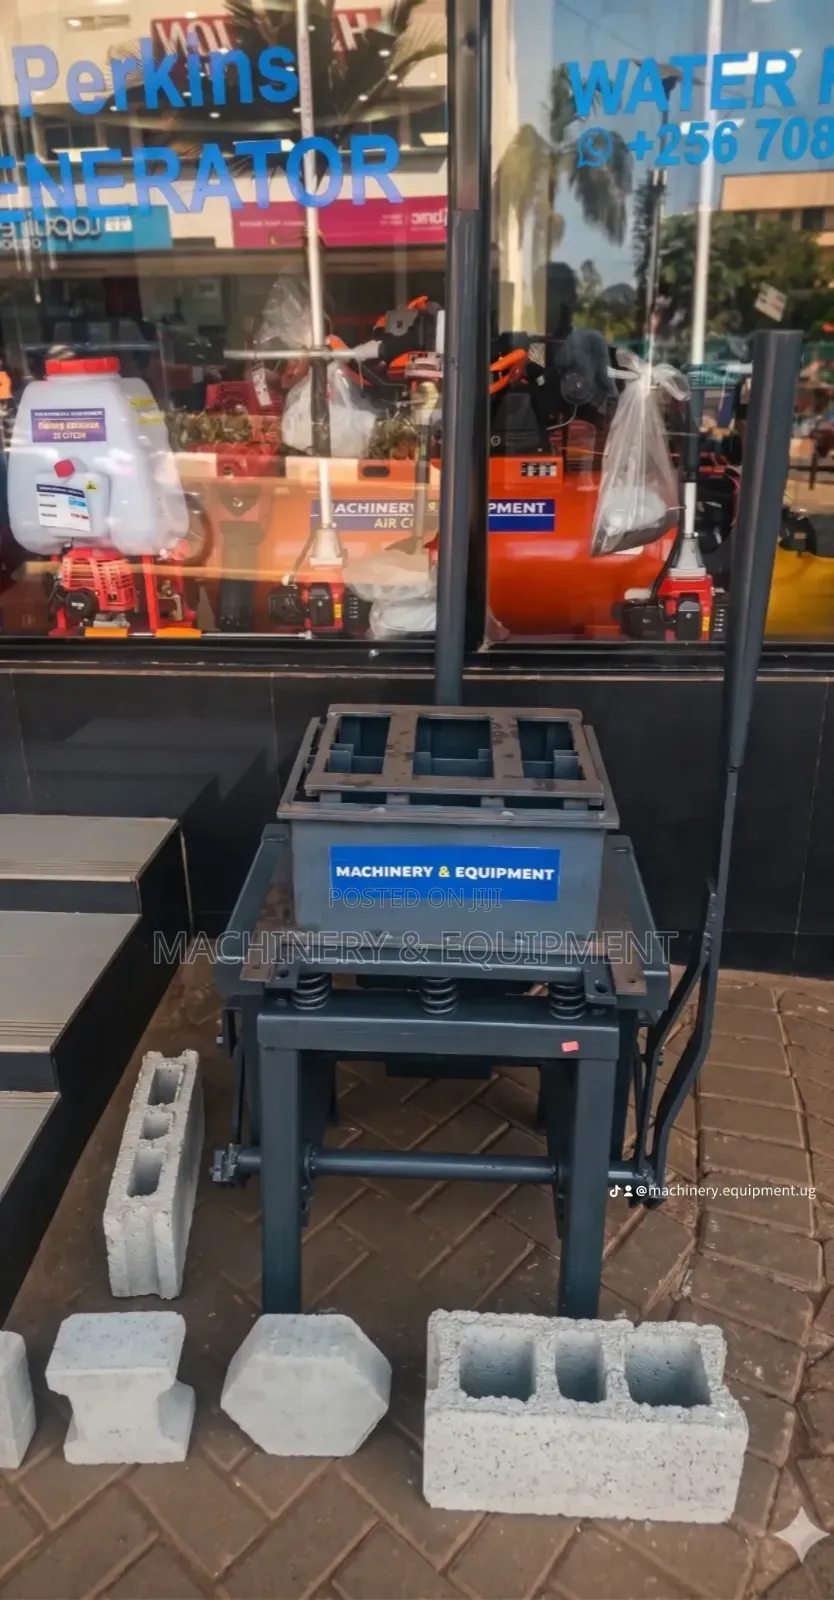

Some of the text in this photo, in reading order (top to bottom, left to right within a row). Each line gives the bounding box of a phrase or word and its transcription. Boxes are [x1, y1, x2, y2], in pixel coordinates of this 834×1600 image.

[11, 35, 300, 118] Perkins
[568, 50, 796, 116] WATER
[627, 115, 834, 166] +256 708
[335, 502, 414, 514] ACHINER
[374, 518, 397, 529] AIR
[336, 866, 554, 880] MACHINERY & EQUIPMENT
